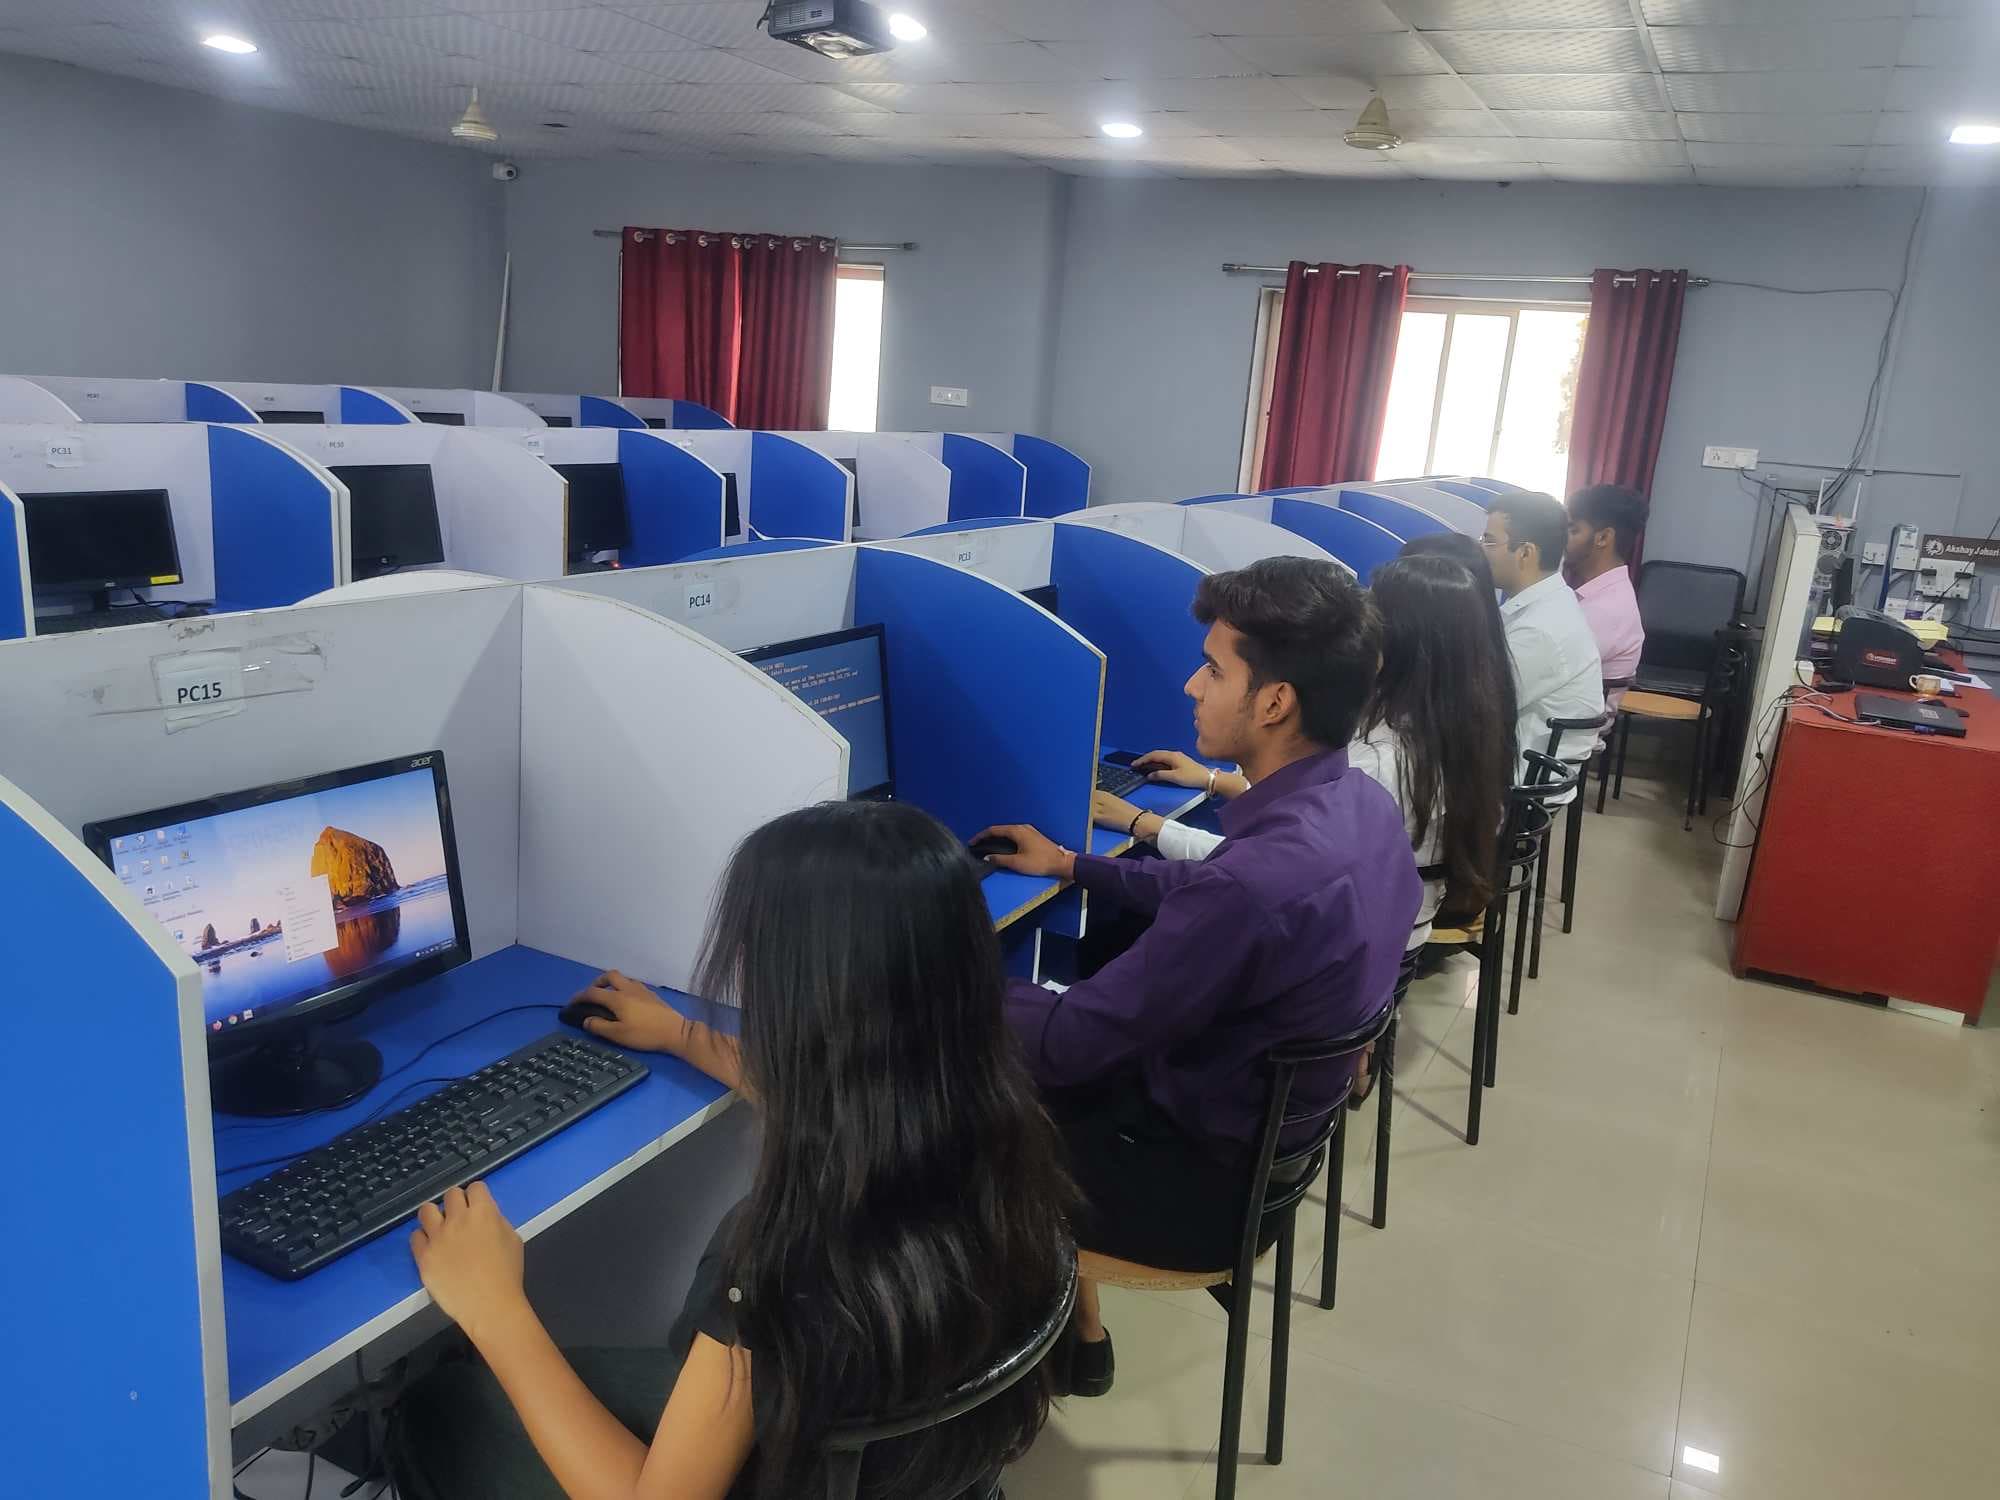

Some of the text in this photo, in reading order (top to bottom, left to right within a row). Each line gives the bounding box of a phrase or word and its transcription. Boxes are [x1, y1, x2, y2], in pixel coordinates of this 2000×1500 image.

[1945, 544, 1974, 556] Akshay
[689, 593, 711, 608] PC14
[177, 682, 222, 703] PC15
[411, 756, 433, 767] acer
